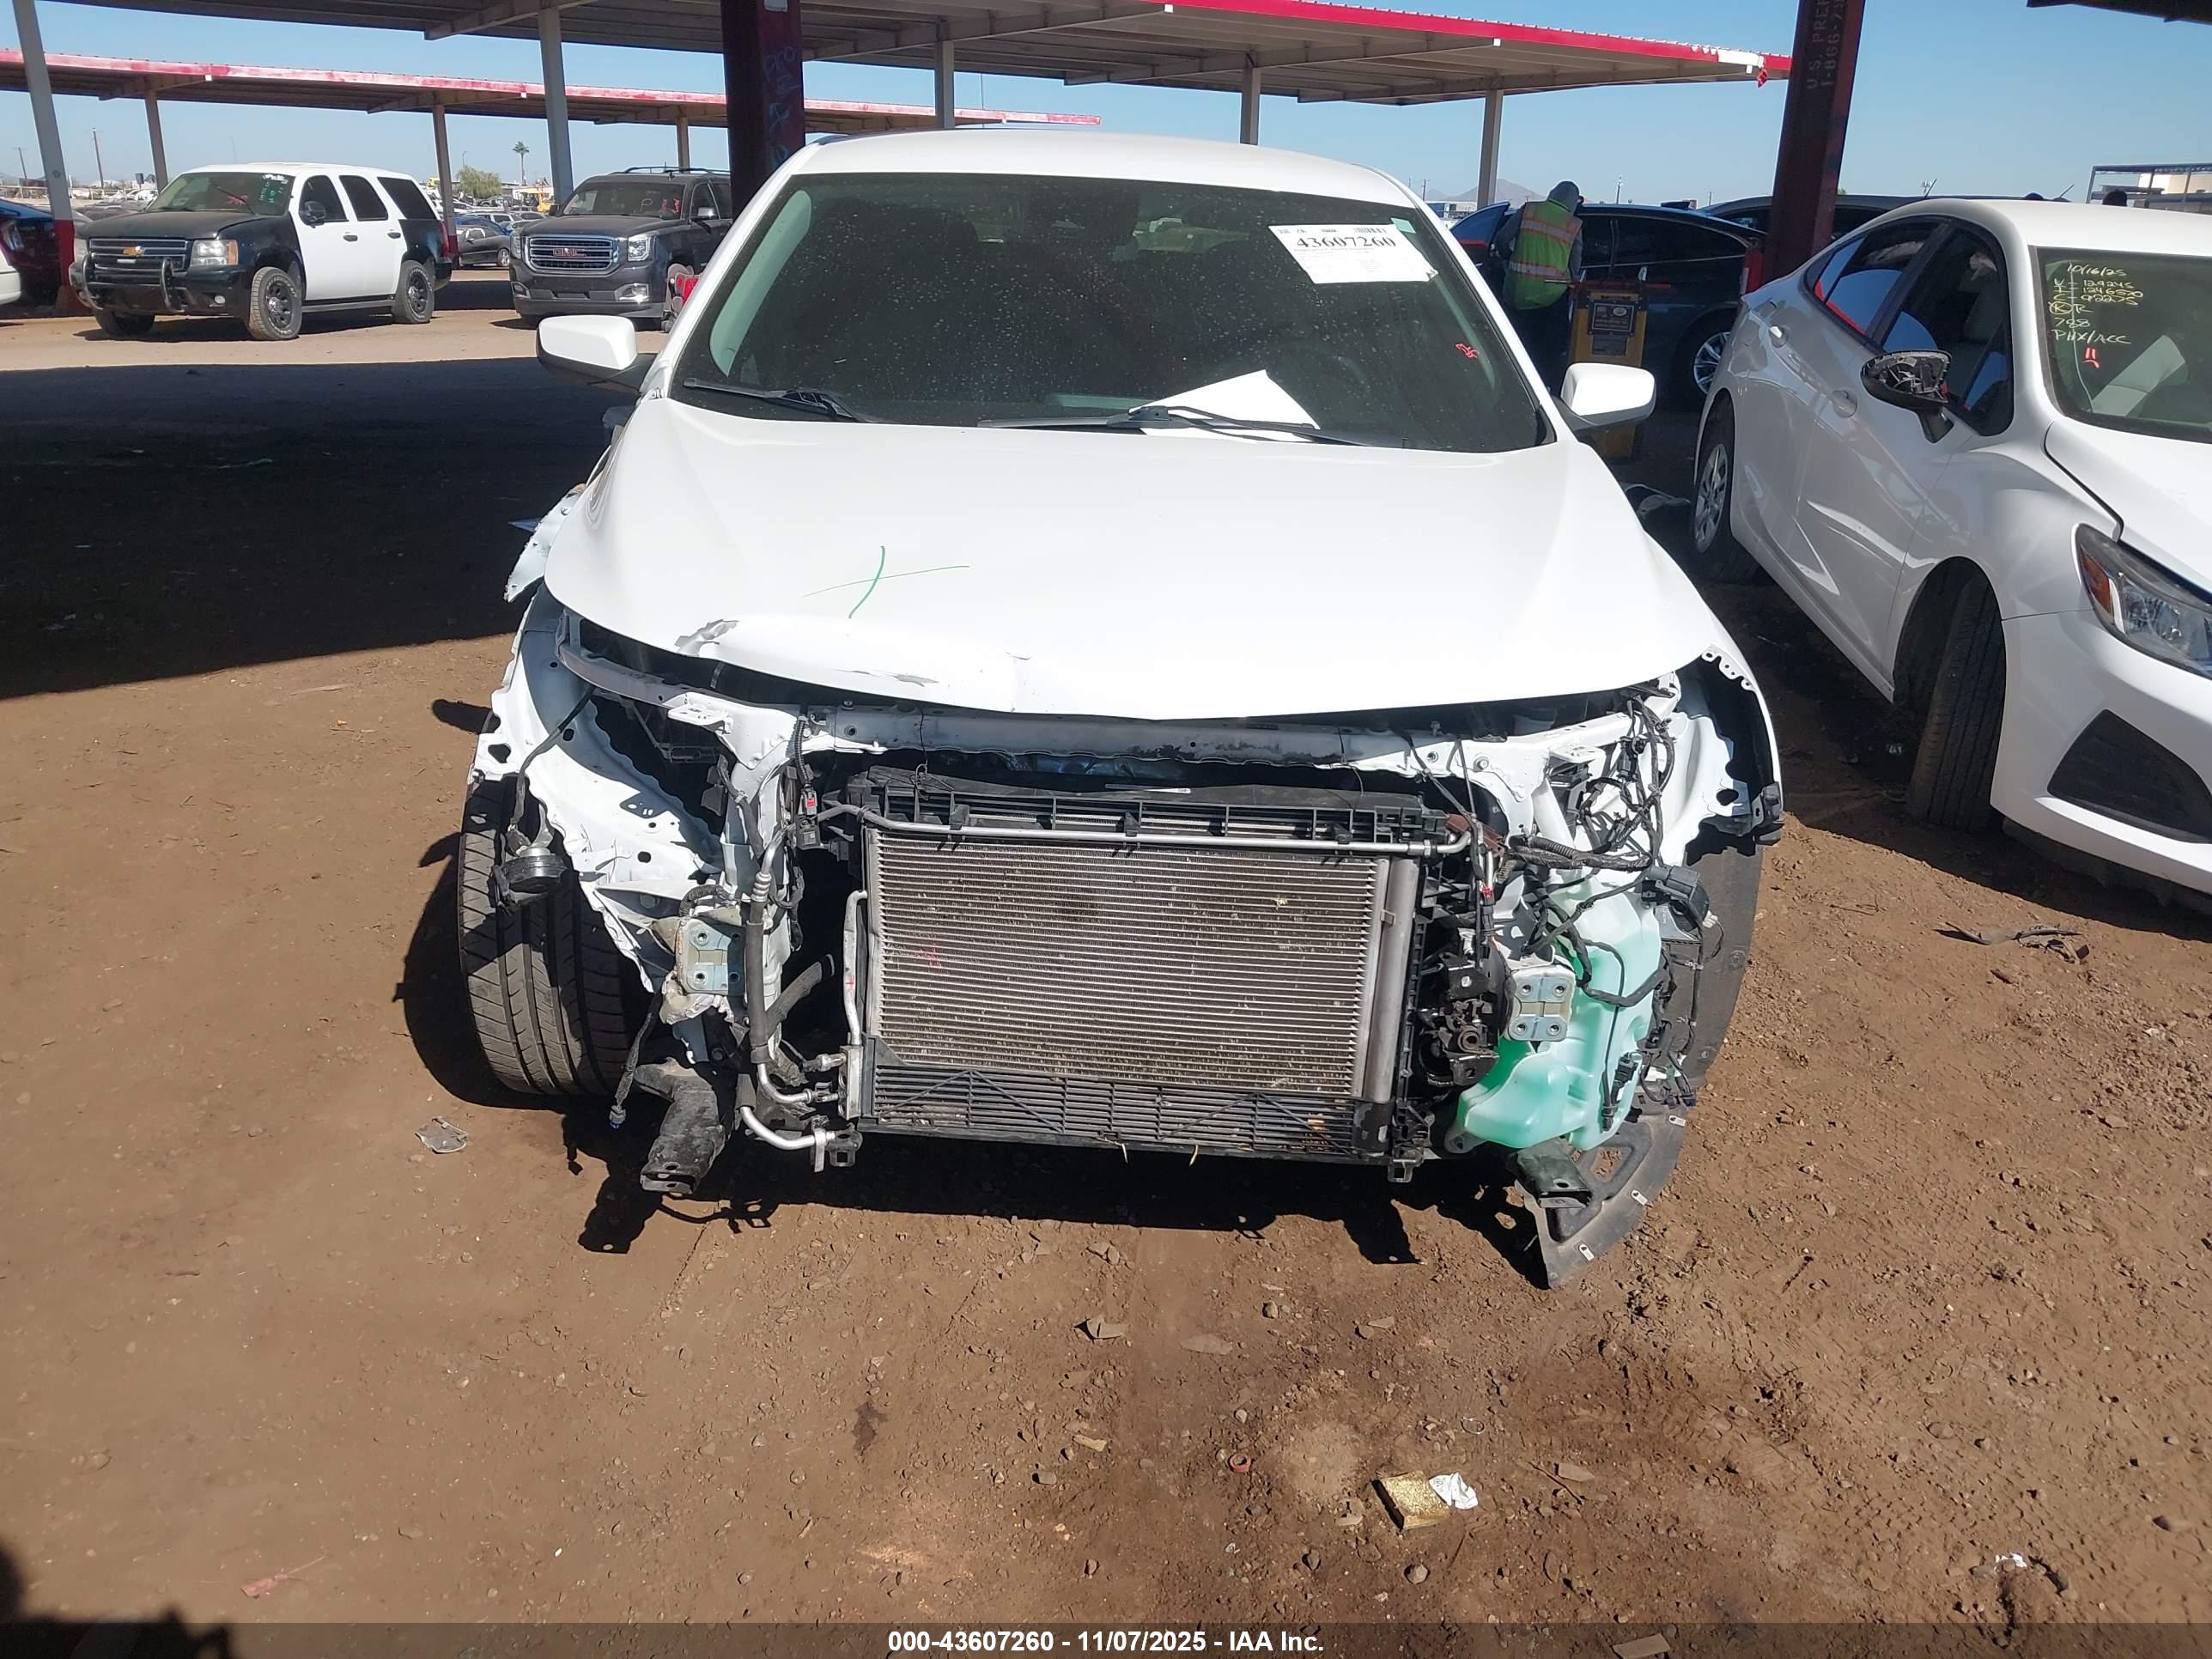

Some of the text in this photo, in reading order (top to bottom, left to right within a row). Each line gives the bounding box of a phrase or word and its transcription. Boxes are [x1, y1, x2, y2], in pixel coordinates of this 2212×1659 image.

[1297, 236, 1396, 247] 43607260
[2067, 263, 2128, 276] 10/16/25
[2053, 317, 2090, 328] 788
